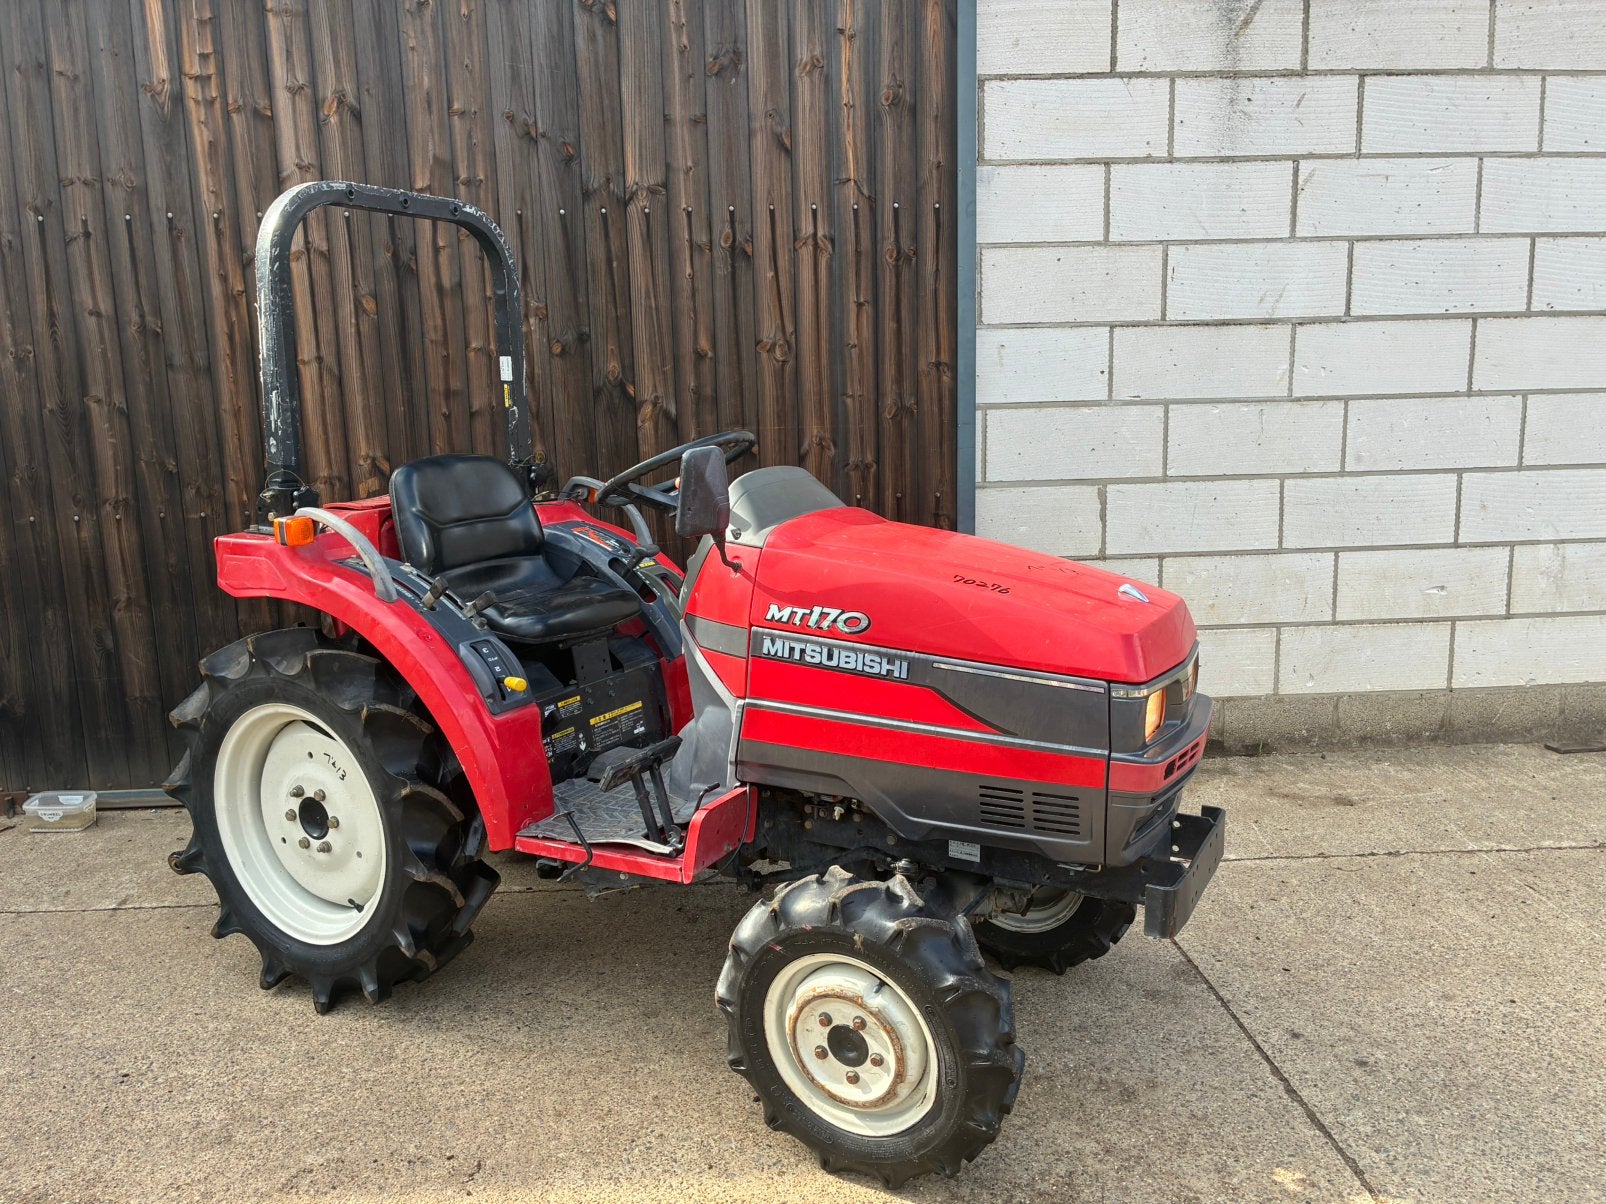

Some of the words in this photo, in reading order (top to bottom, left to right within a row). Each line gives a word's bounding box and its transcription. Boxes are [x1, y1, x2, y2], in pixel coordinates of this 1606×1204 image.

[953, 574, 1010, 594] 70276
[765, 603, 871, 634] MT170
[762, 635, 909, 679] MITSUBISHI
